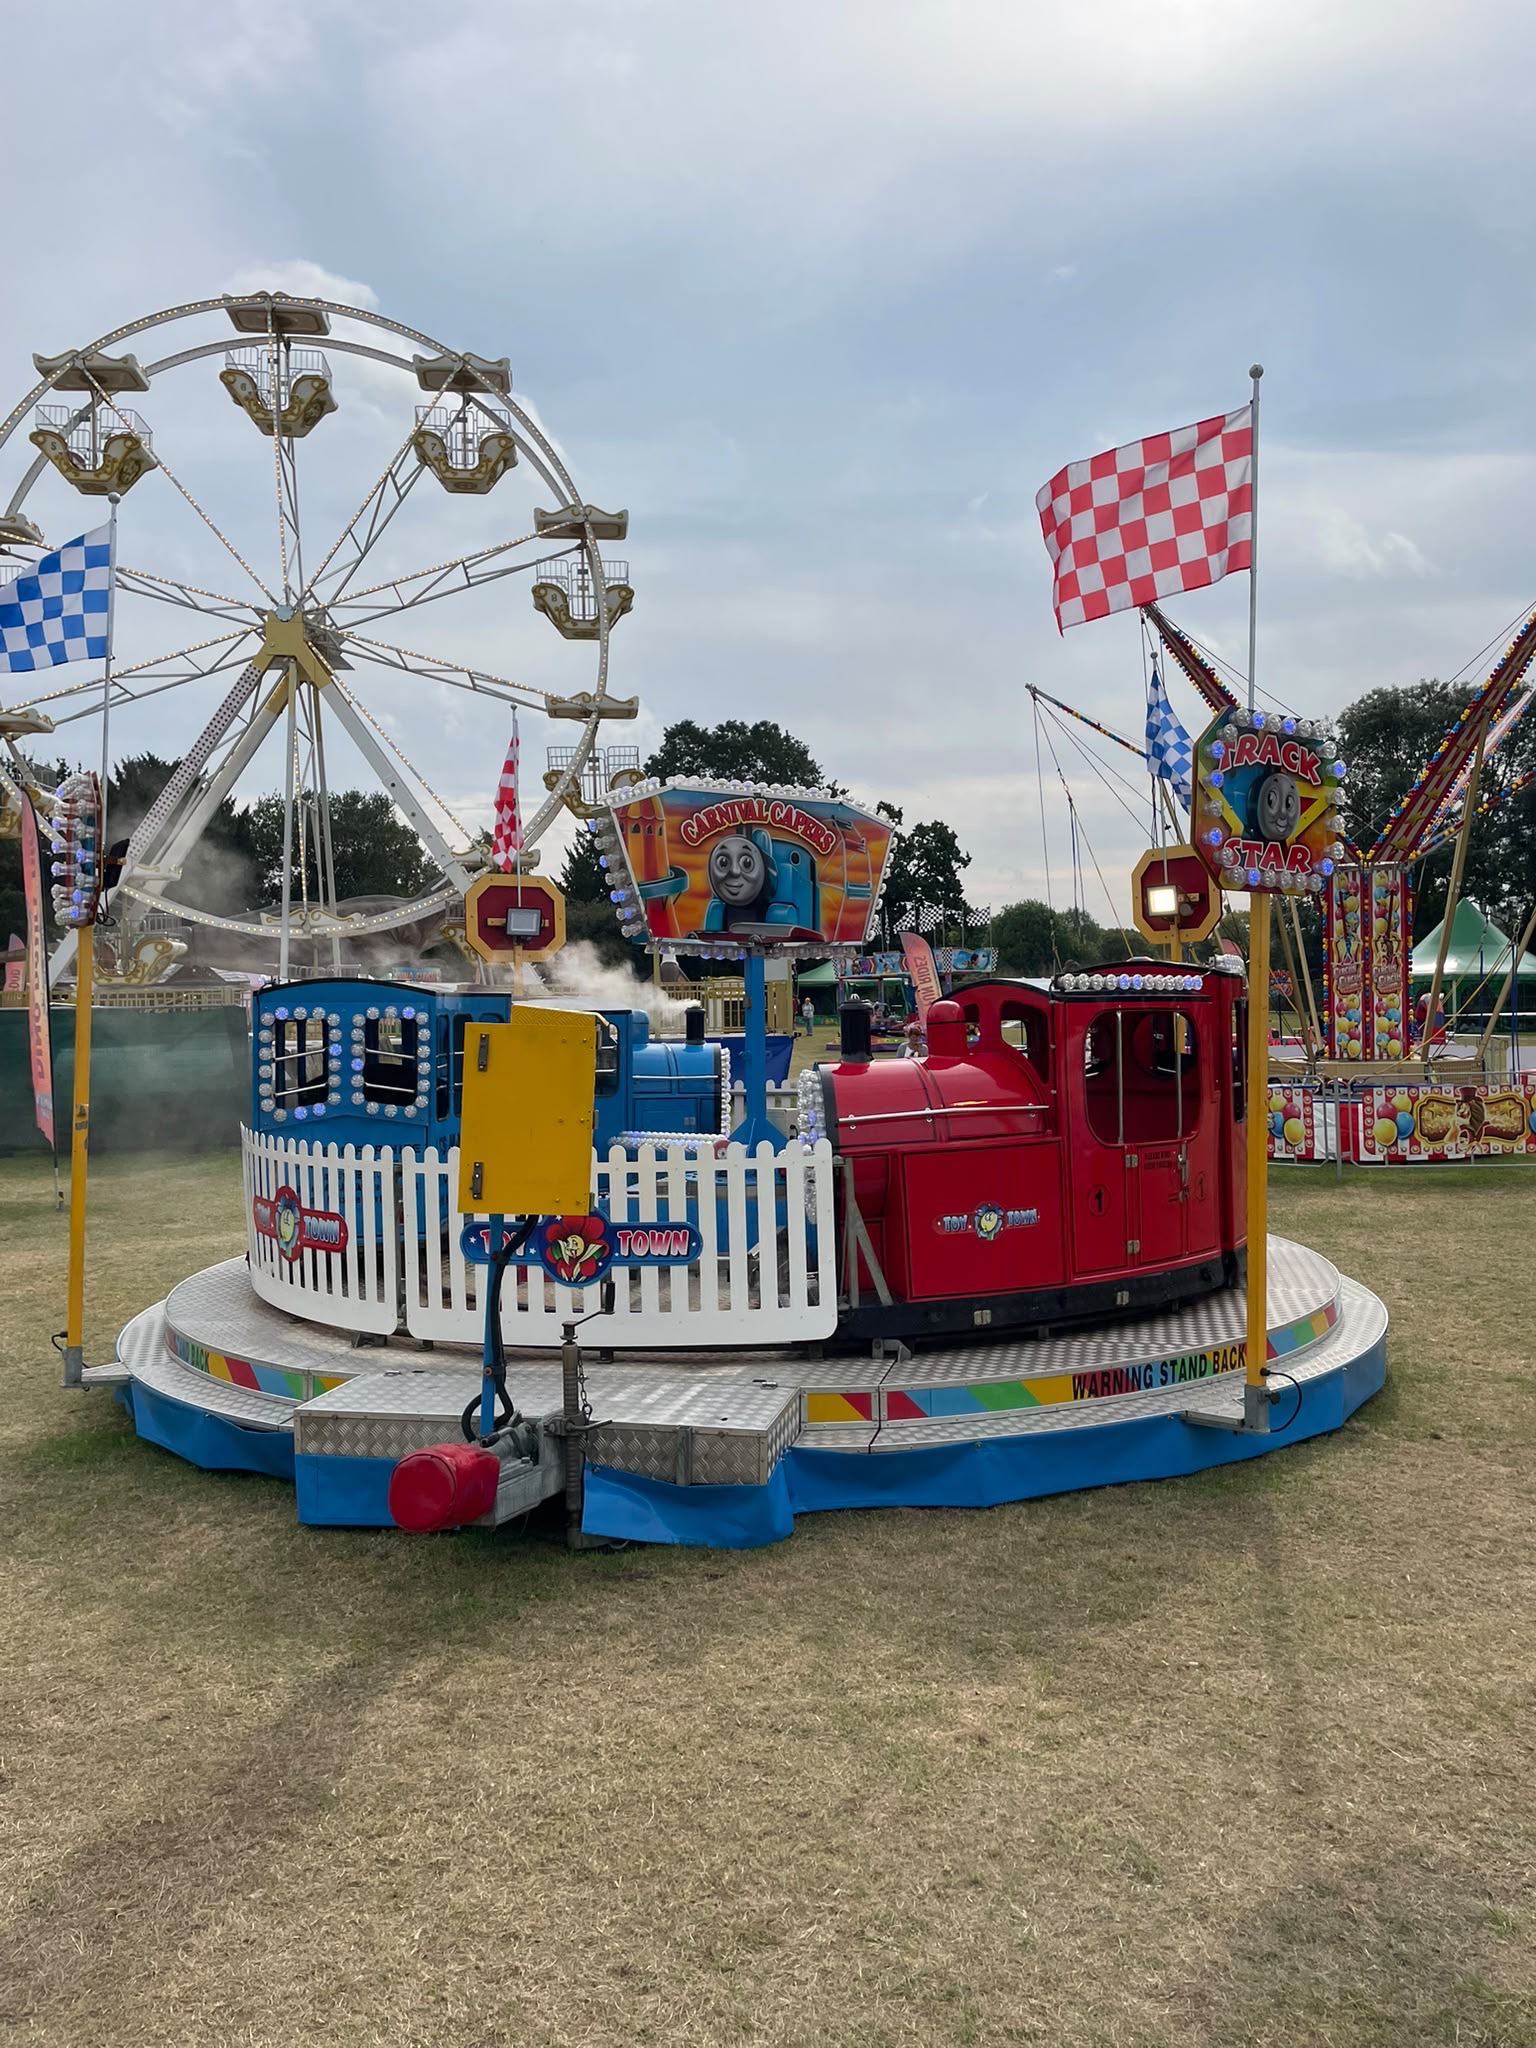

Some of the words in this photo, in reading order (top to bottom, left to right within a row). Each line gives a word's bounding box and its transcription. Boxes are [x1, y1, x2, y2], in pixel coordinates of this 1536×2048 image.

[1219, 734, 1321, 785] TRACK
[681, 799, 769, 846] CARNIVAL
[769, 801, 836, 854] CAPERS
[1224, 838, 1311, 874] STAR
[1095, 1188, 1104, 1213] 1
[303, 1215, 340, 1244] TOWN
[943, 1214, 968, 1232] TOY
[617, 1229, 689, 1257] TOWN
[1072, 1364, 1153, 1400] WARNING
[1159, 1354, 1208, 1386] STAND
[1212, 1344, 1246, 1375] BACK
